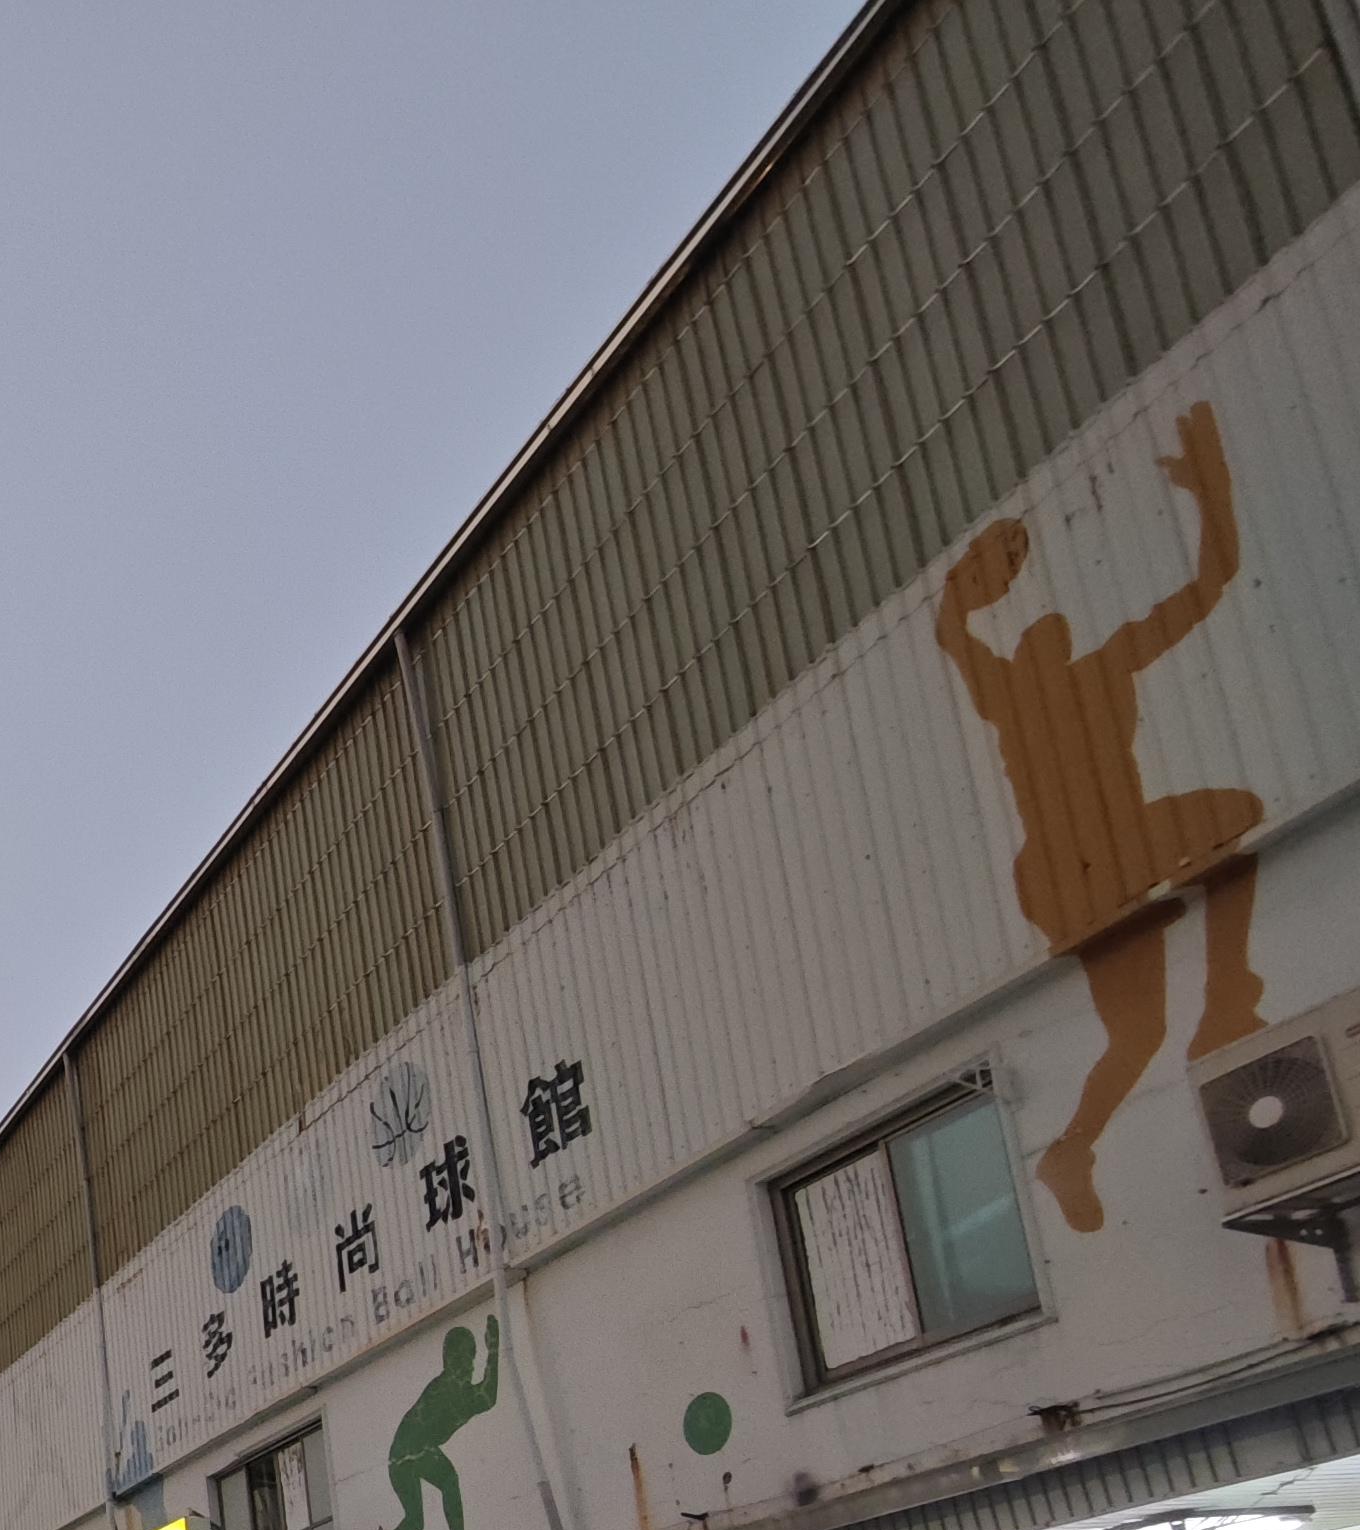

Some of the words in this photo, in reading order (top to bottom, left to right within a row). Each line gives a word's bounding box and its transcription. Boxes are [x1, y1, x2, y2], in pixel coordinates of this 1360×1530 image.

[150, 1059, 593, 1413] 三多時尚球館
